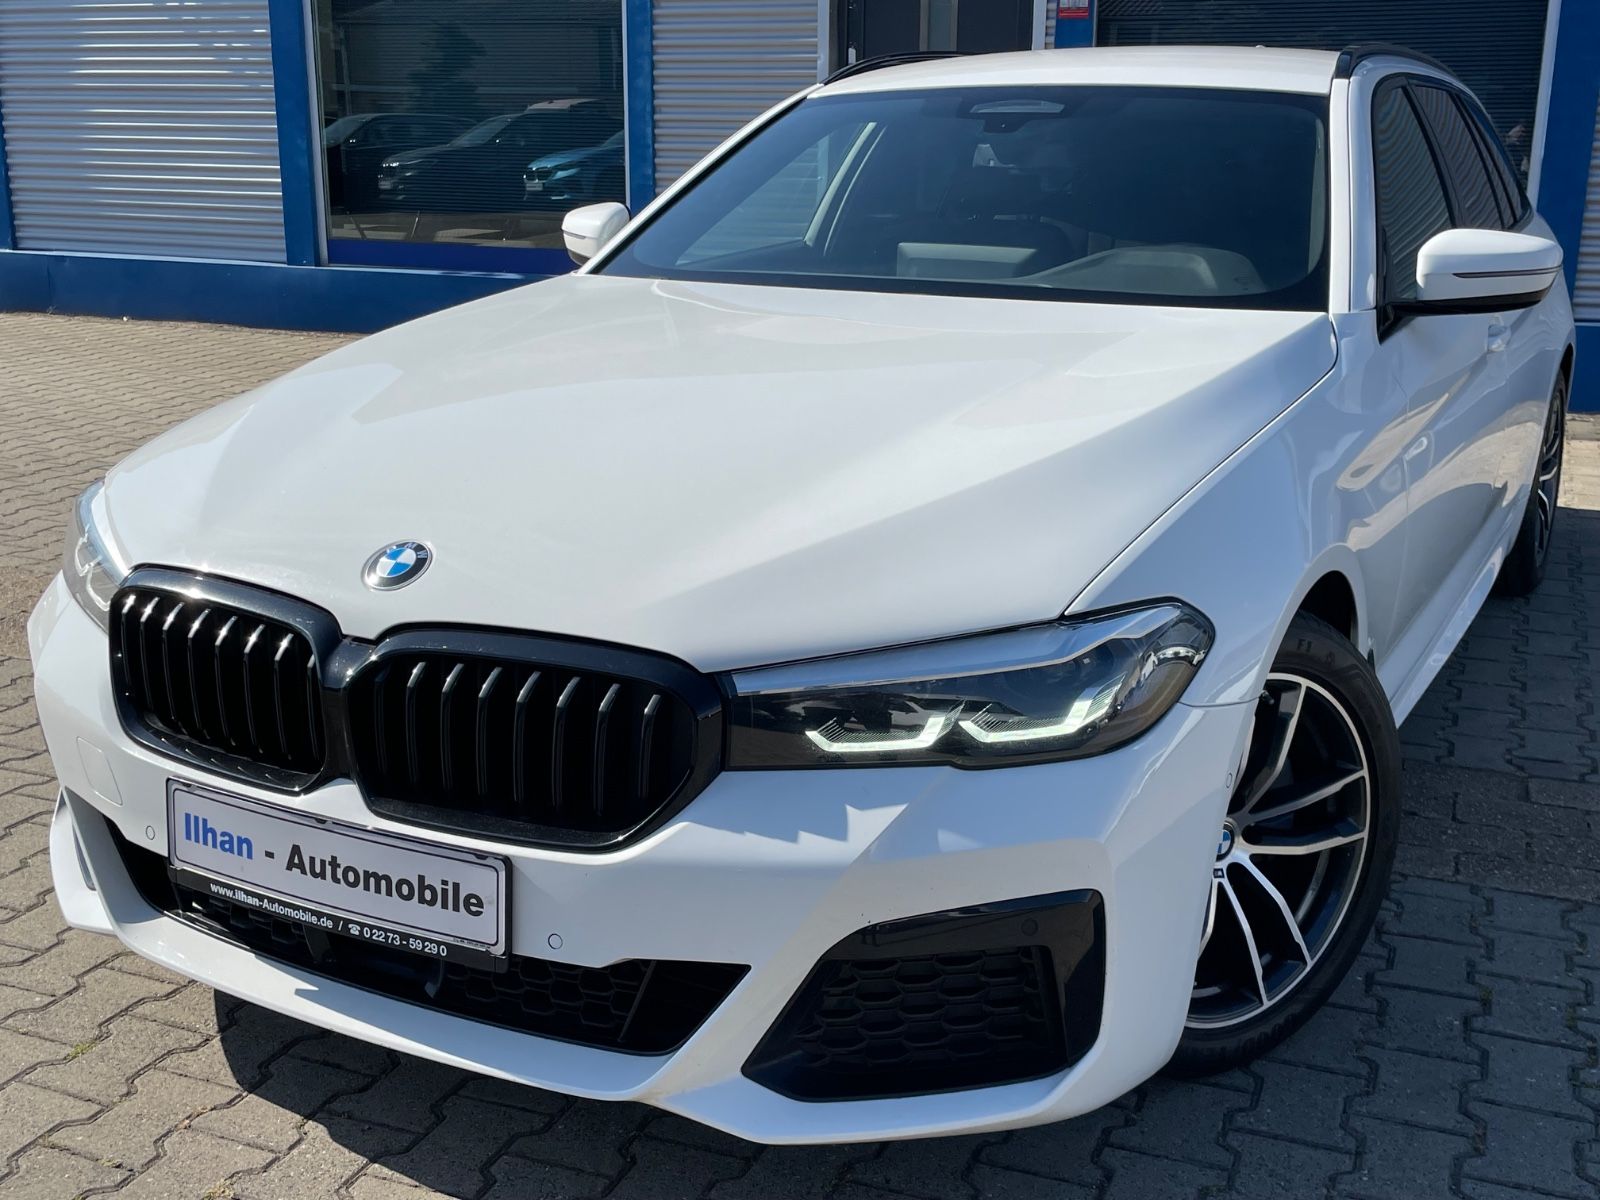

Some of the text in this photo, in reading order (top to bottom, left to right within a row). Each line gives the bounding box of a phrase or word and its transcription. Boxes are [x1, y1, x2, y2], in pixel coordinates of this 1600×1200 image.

[184, 812, 485, 917] Ilhan - Automobile
